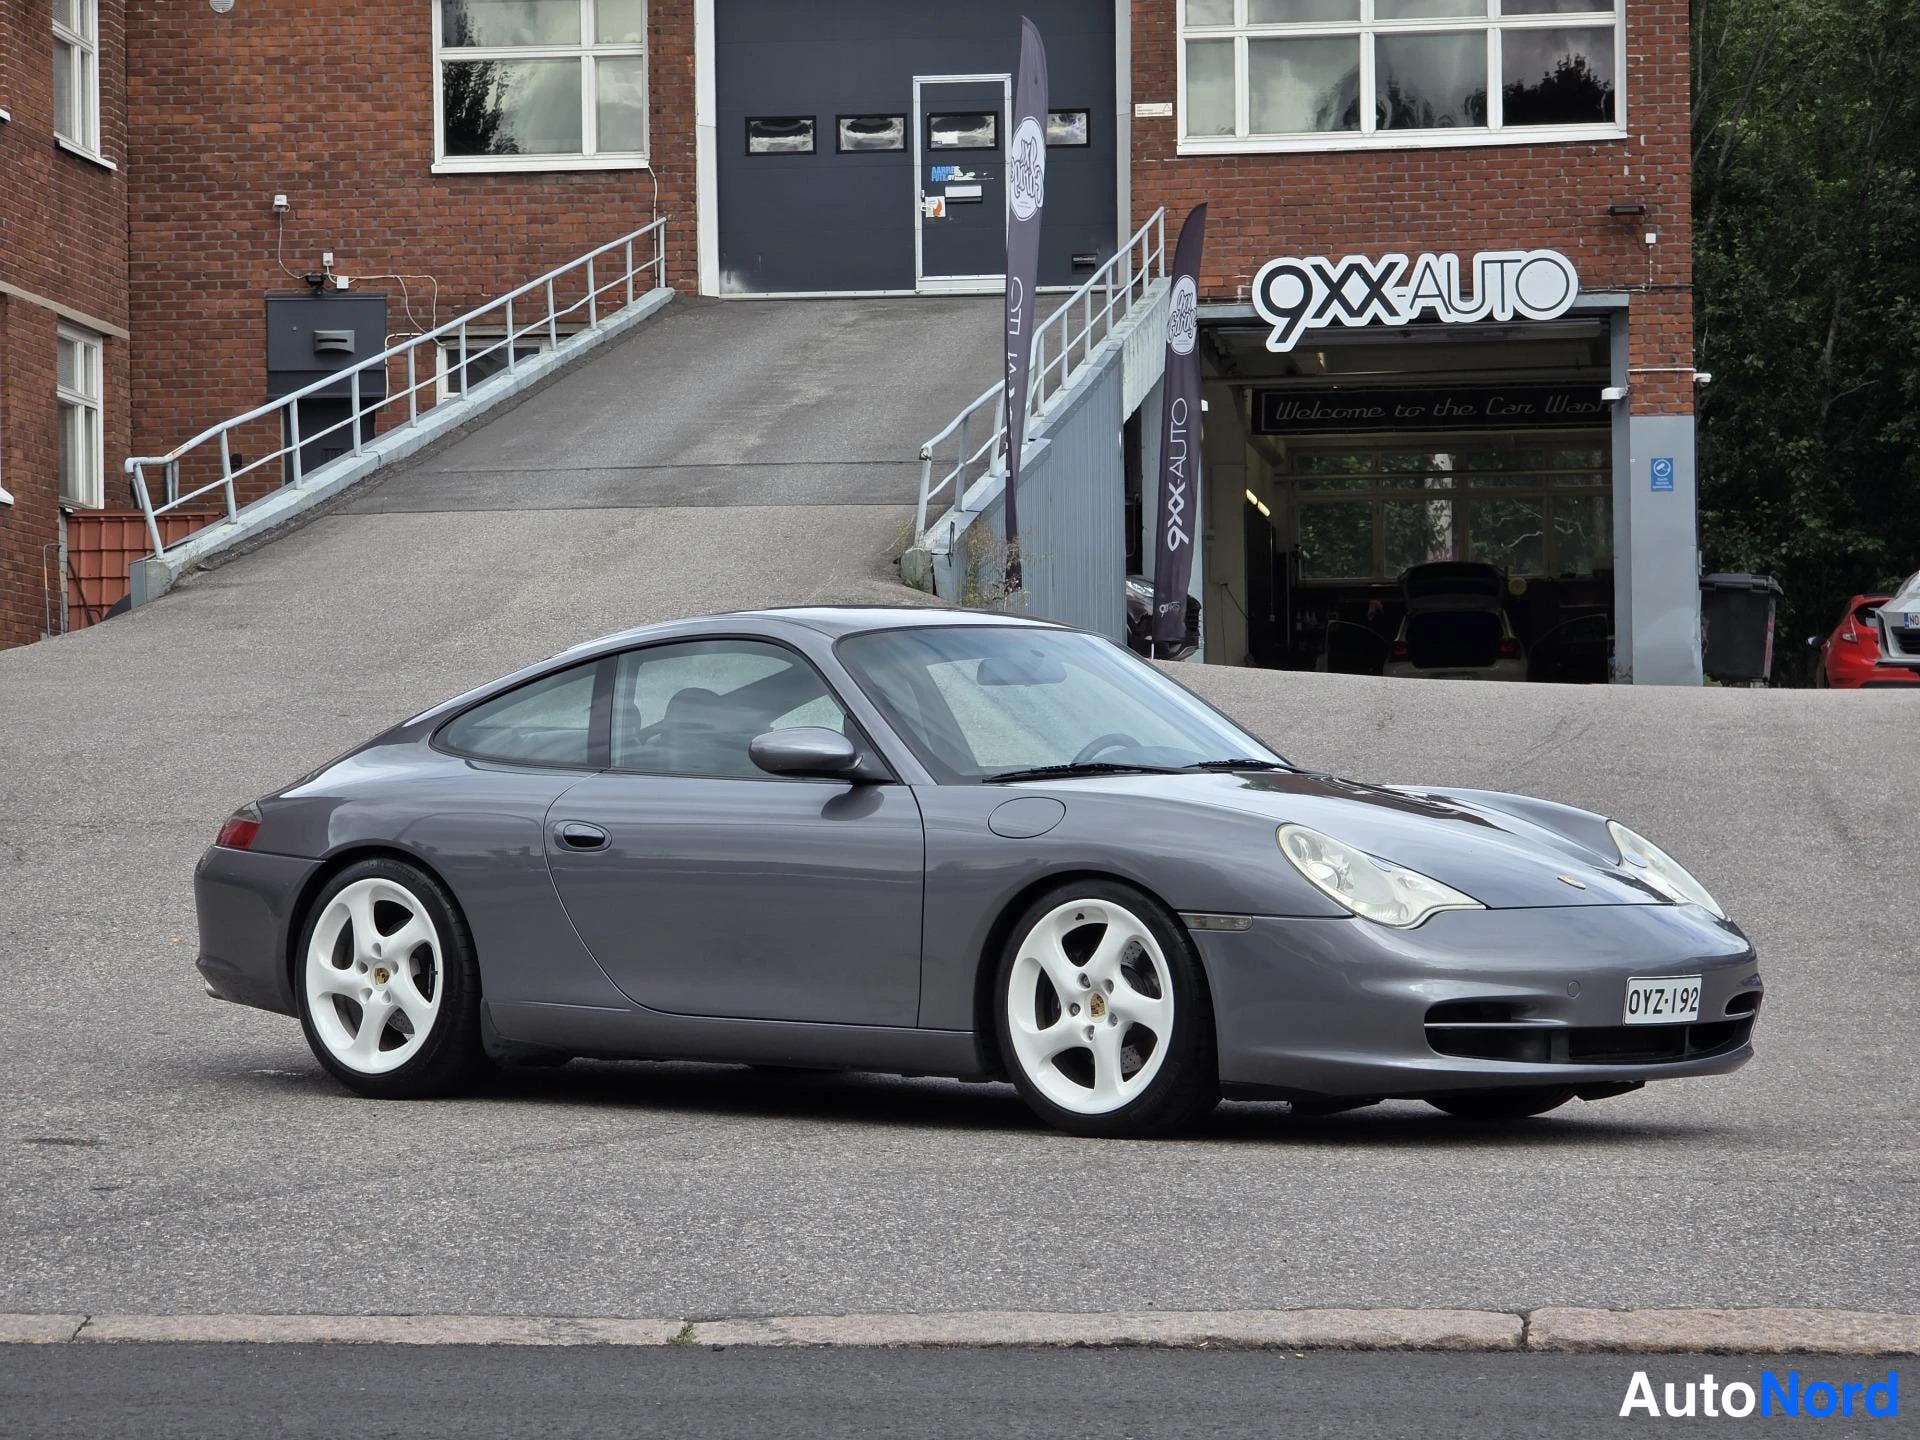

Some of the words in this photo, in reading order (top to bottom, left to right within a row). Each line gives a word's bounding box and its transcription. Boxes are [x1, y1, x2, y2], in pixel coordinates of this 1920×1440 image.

[1260, 256, 1570, 344] 9XX-AUTO
[1275, 401, 1387, 420] Welcome
[1395, 402, 1426, 418] to
[1432, 398, 1478, 417] the
[1486, 396, 1536, 416] Car
[1545, 394, 1612, 414] Wash
[1167, 397, 1190, 552] 9XX-AUTO
[1628, 986, 1699, 1015] OYZ-192
